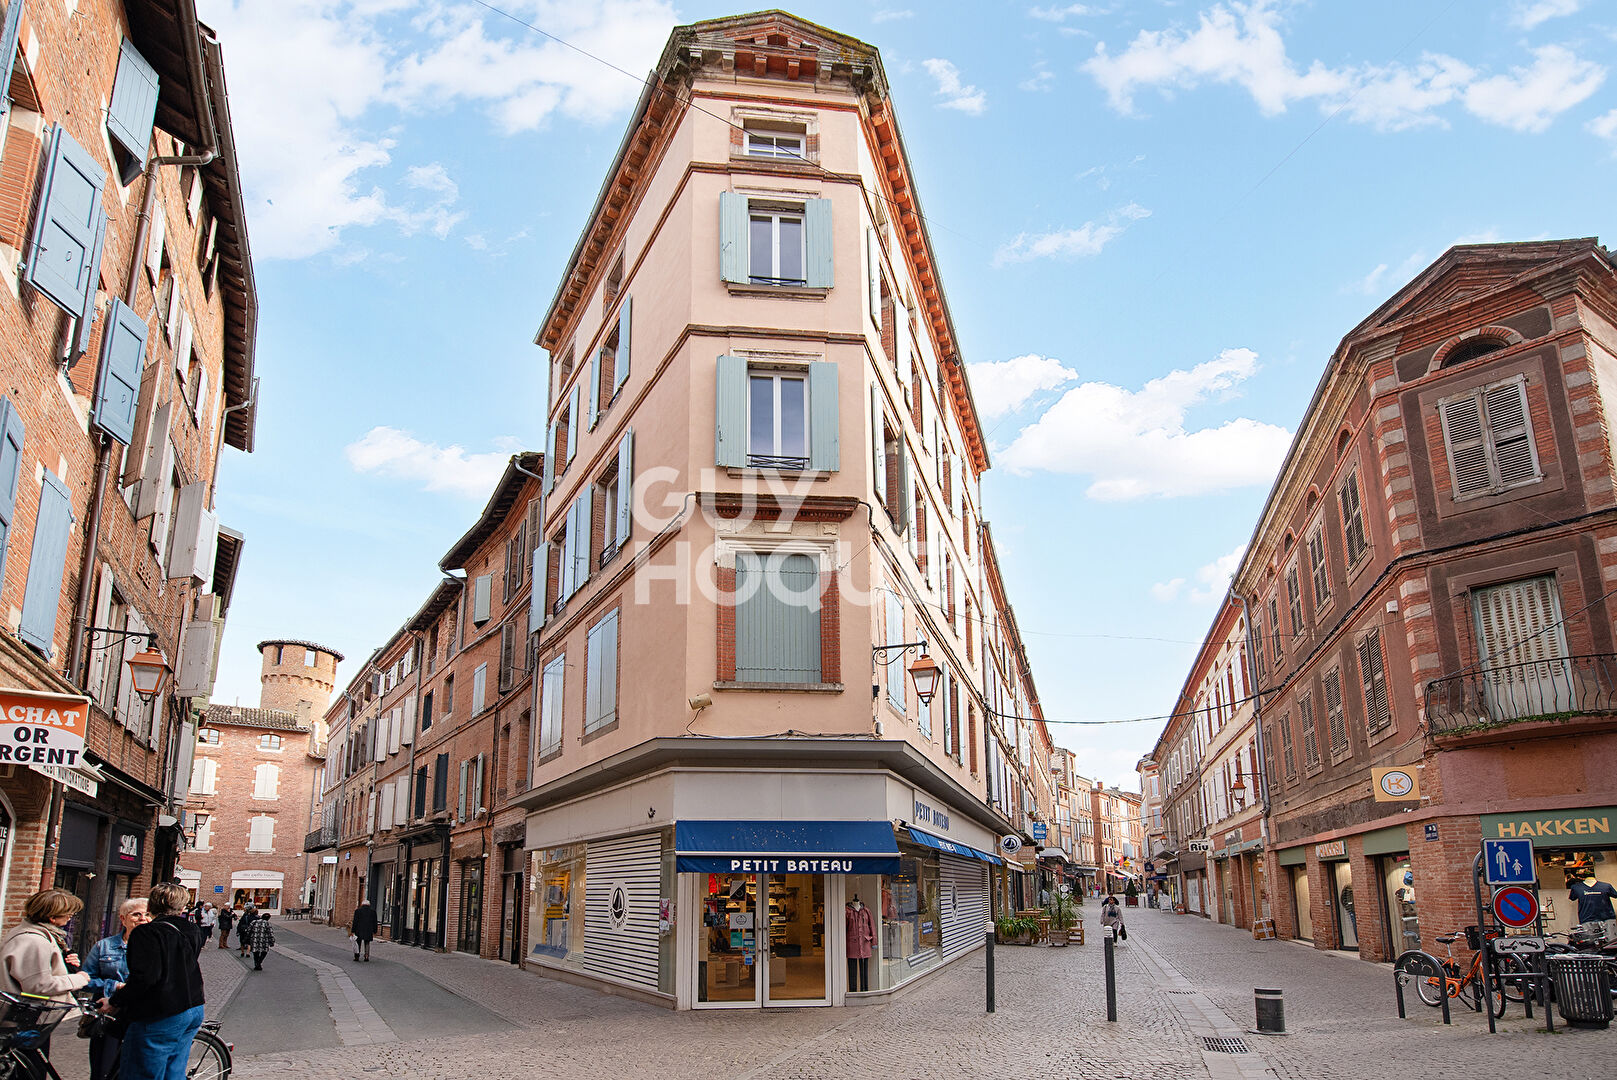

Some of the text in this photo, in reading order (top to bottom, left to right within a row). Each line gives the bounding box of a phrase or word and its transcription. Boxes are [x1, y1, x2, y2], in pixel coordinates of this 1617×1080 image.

[14, 726, 49, 745] OR
[915, 800, 950, 832] PETIT BATEAU
[1497, 817, 1611, 838] HAKKEN
[730, 859, 854, 872] PETIT BATEAU
